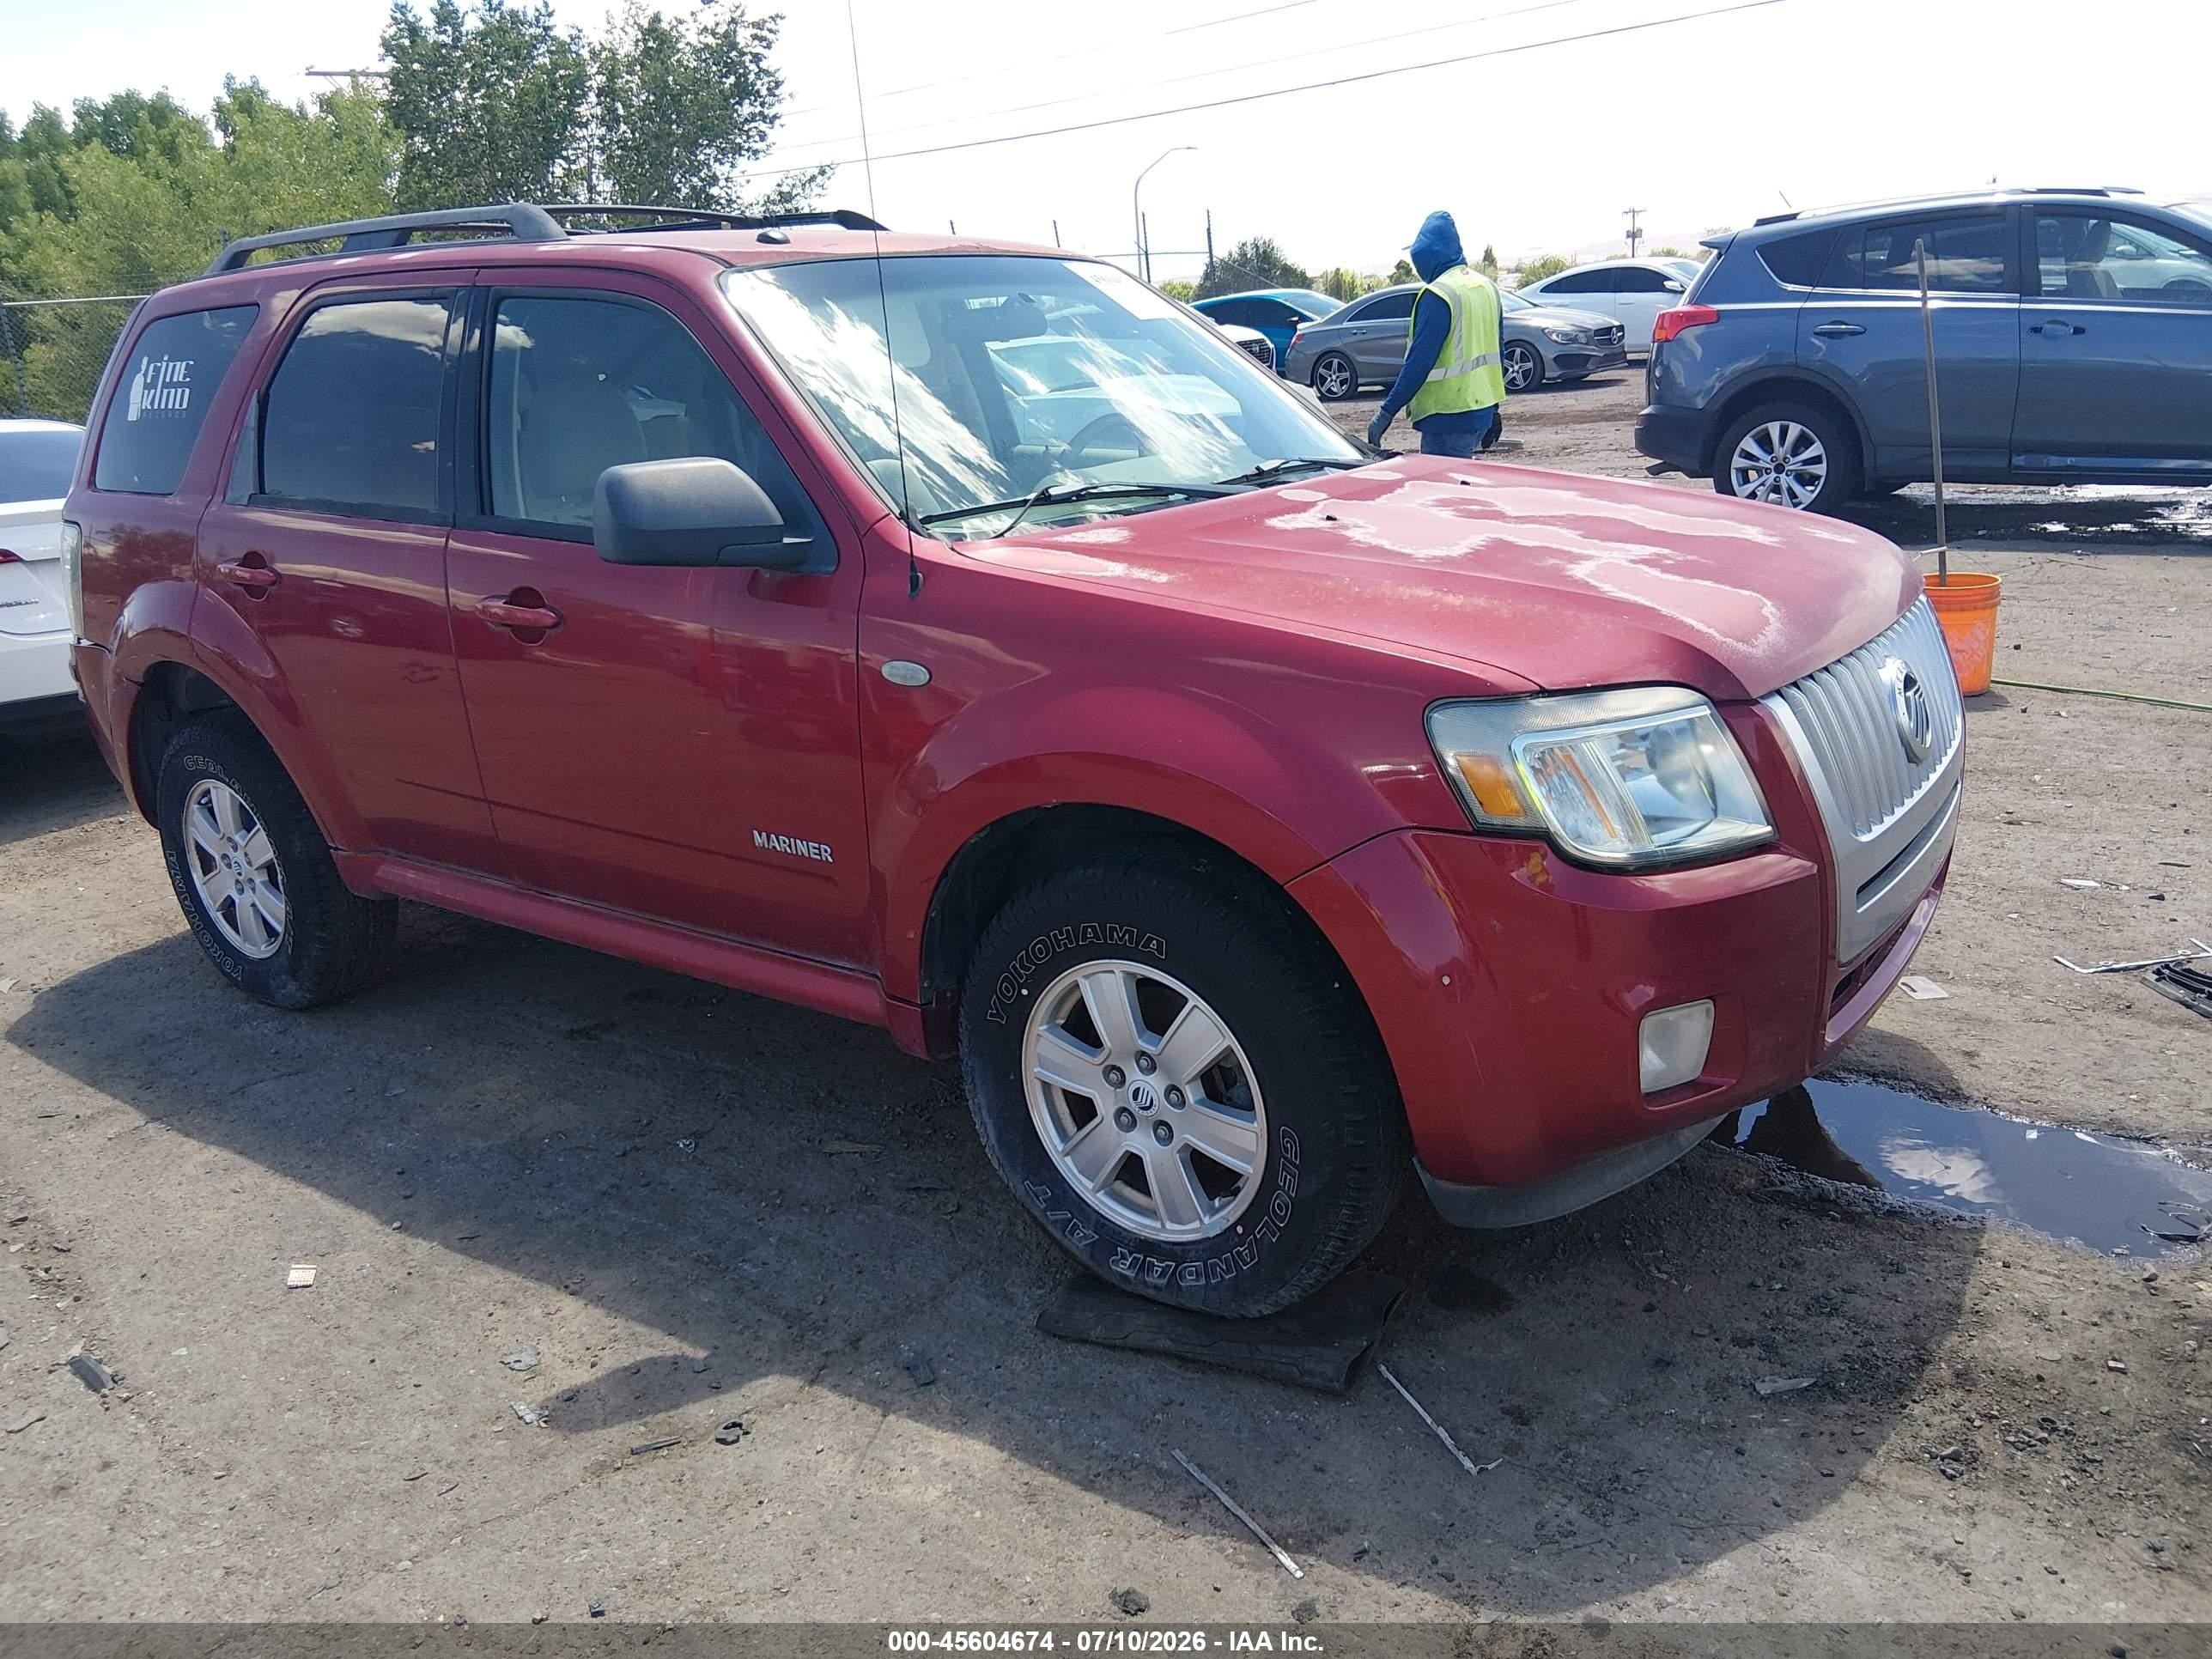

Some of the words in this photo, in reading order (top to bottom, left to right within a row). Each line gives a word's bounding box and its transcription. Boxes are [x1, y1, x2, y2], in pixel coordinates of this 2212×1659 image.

[752, 829, 833, 863] MARINER
[166, 850, 244, 981] YOKOHAMA
[986, 922, 1167, 1026] YOKOHAMA
[1024, 1180, 1099, 1246] A/T
[1108, 1126, 1301, 1286] GEOLANDAR
